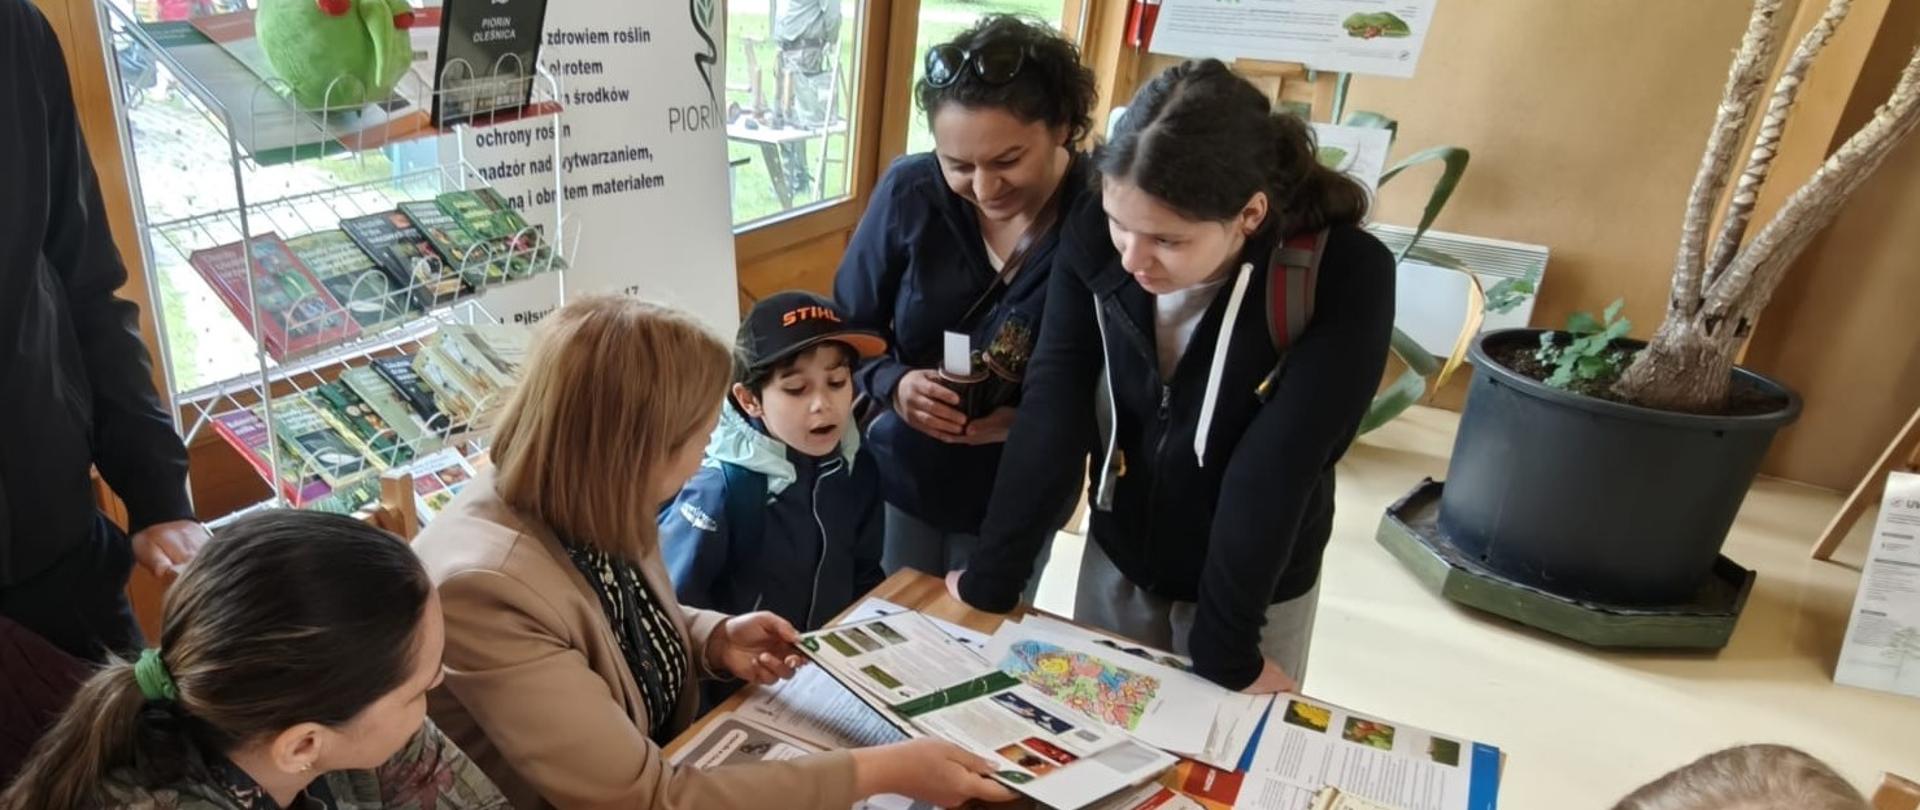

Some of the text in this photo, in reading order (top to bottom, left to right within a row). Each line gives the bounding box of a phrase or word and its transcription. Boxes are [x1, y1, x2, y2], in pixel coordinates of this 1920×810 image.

[547, 26, 651, 46] zdrowiem roślin
[574, 86, 630, 105] środków
[476, 127, 532, 147] ochrony
[478, 158, 526, 181] nadzór
[530, 154, 553, 175] nad
[536, 182, 589, 205] obrtem
[592, 173, 665, 195] materiałem
[782, 306, 841, 327] STIHL
